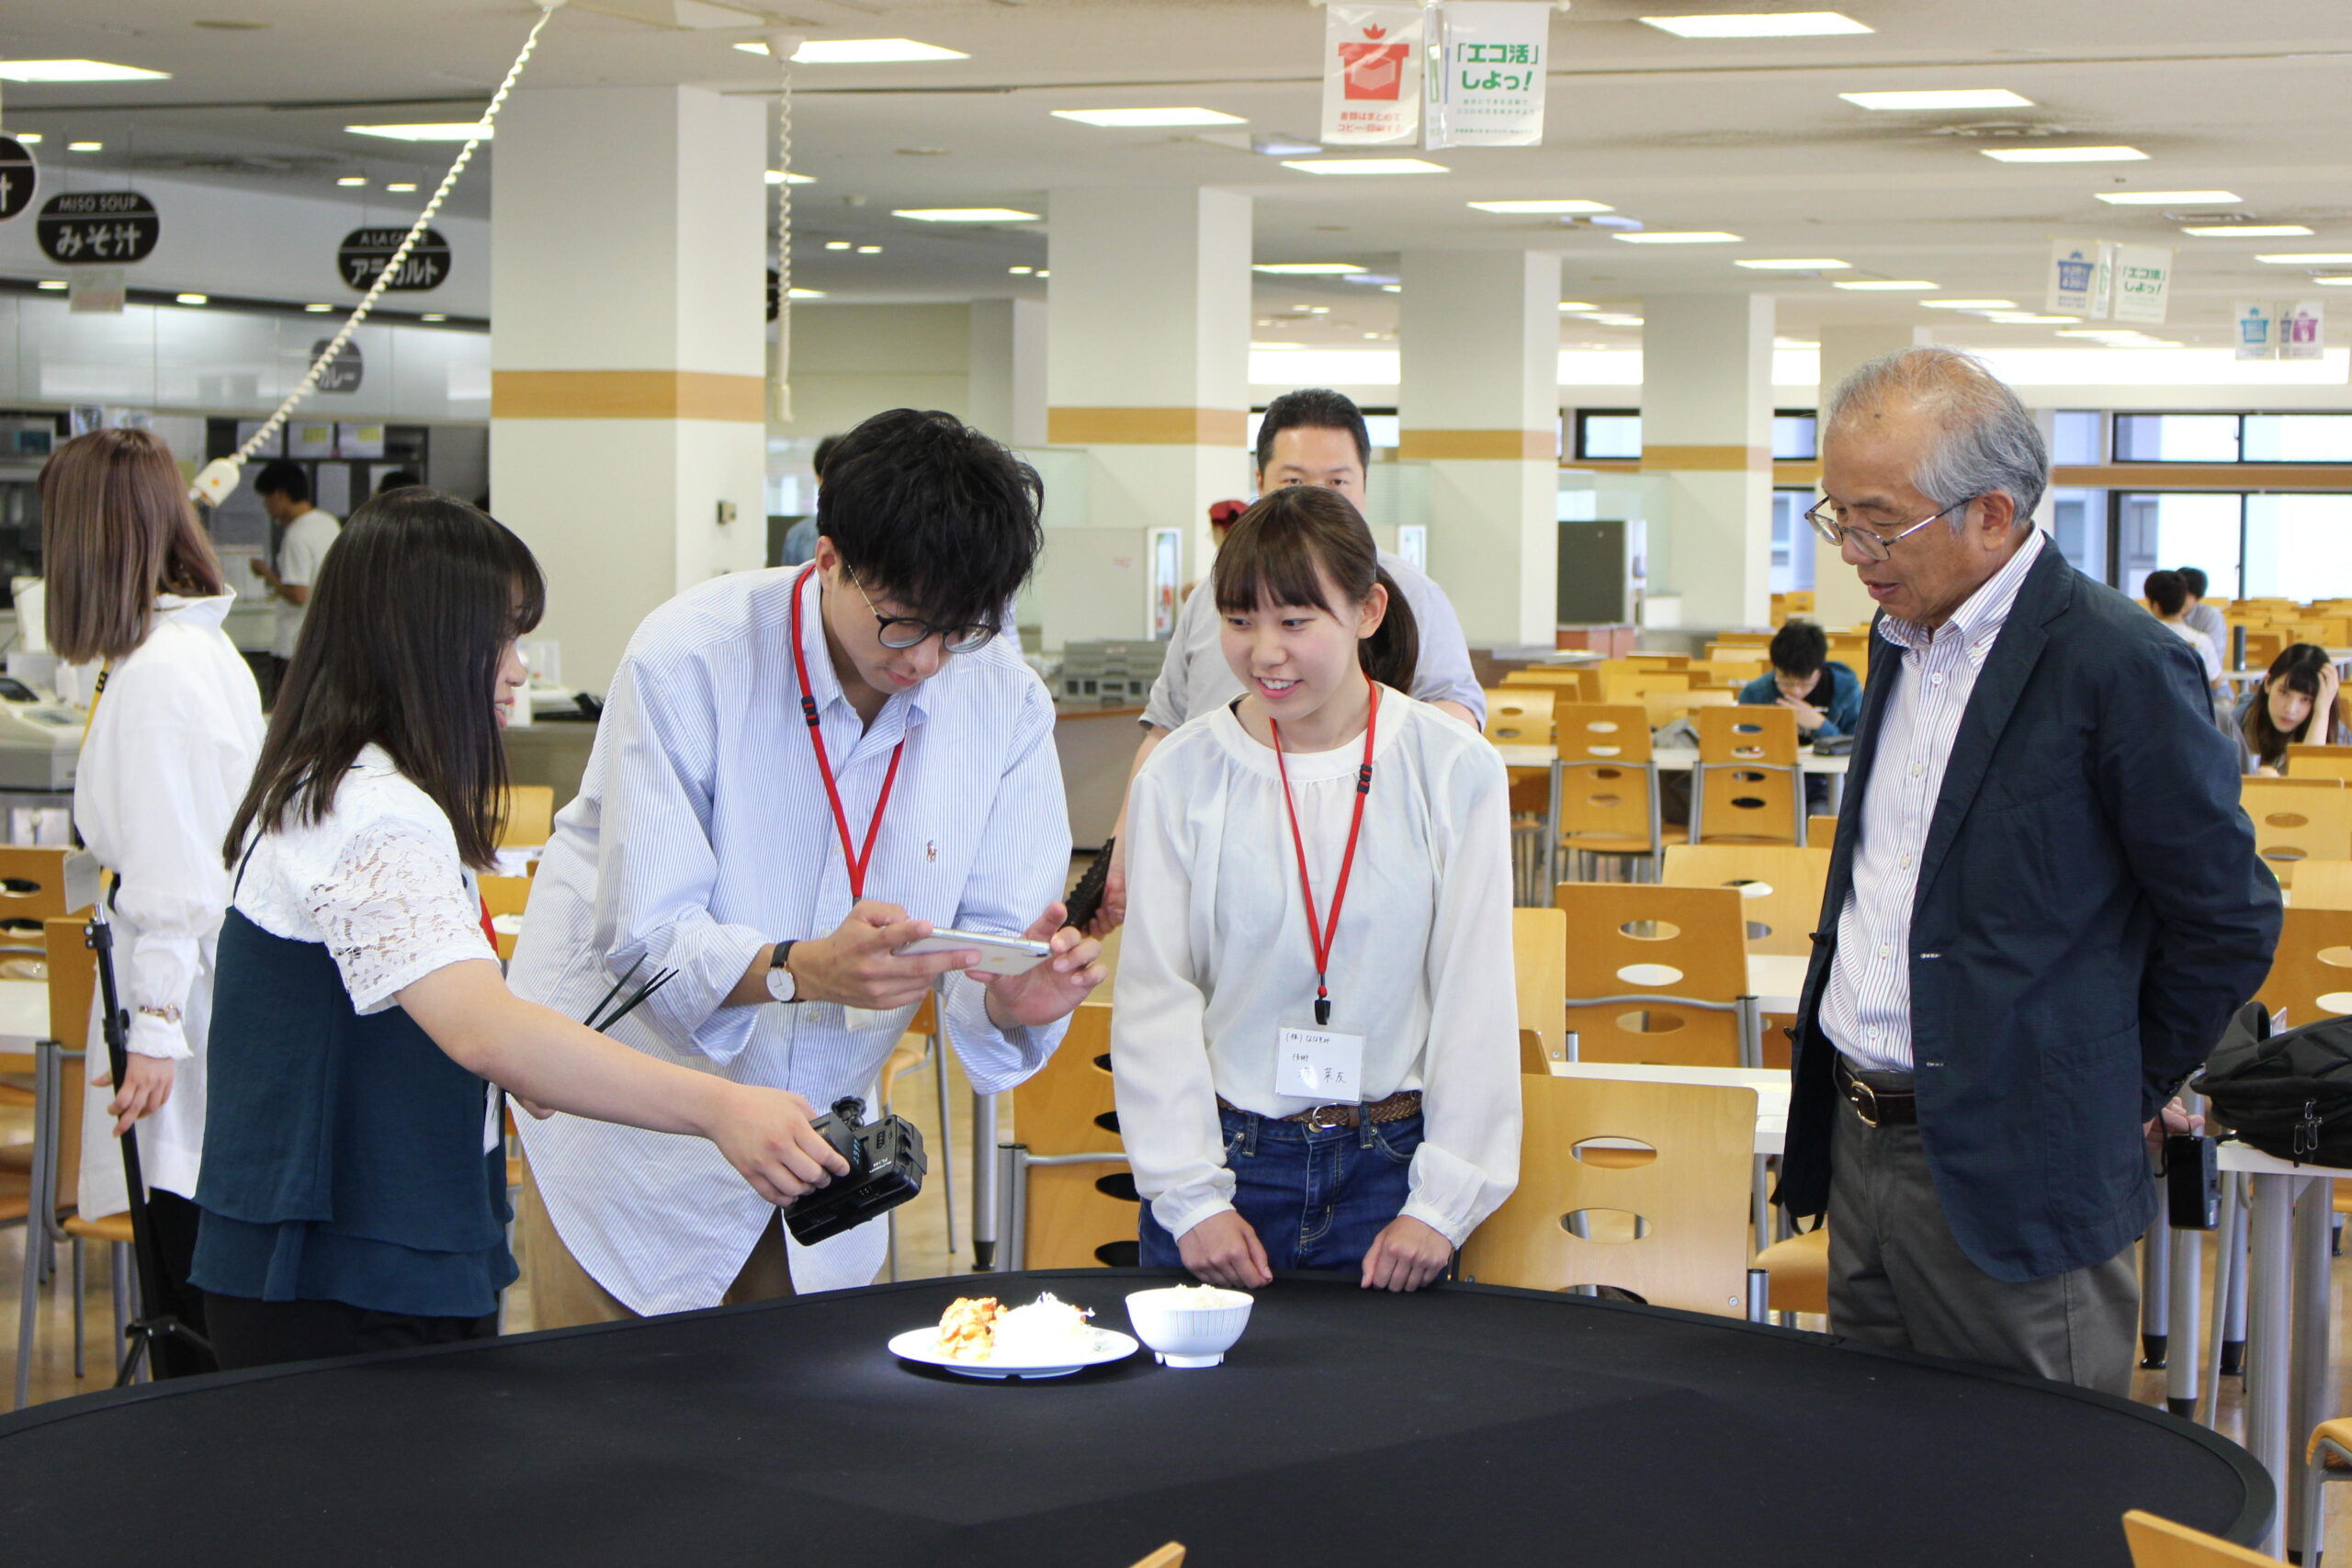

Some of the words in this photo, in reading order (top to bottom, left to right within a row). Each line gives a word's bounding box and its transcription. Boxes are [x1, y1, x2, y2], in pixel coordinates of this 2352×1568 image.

[1457, 42, 1539, 64] 「エコ活」
[59, 197, 96, 212] MISO
[99, 194, 138, 211] SOUP
[55, 220, 141, 257] みそ汁
